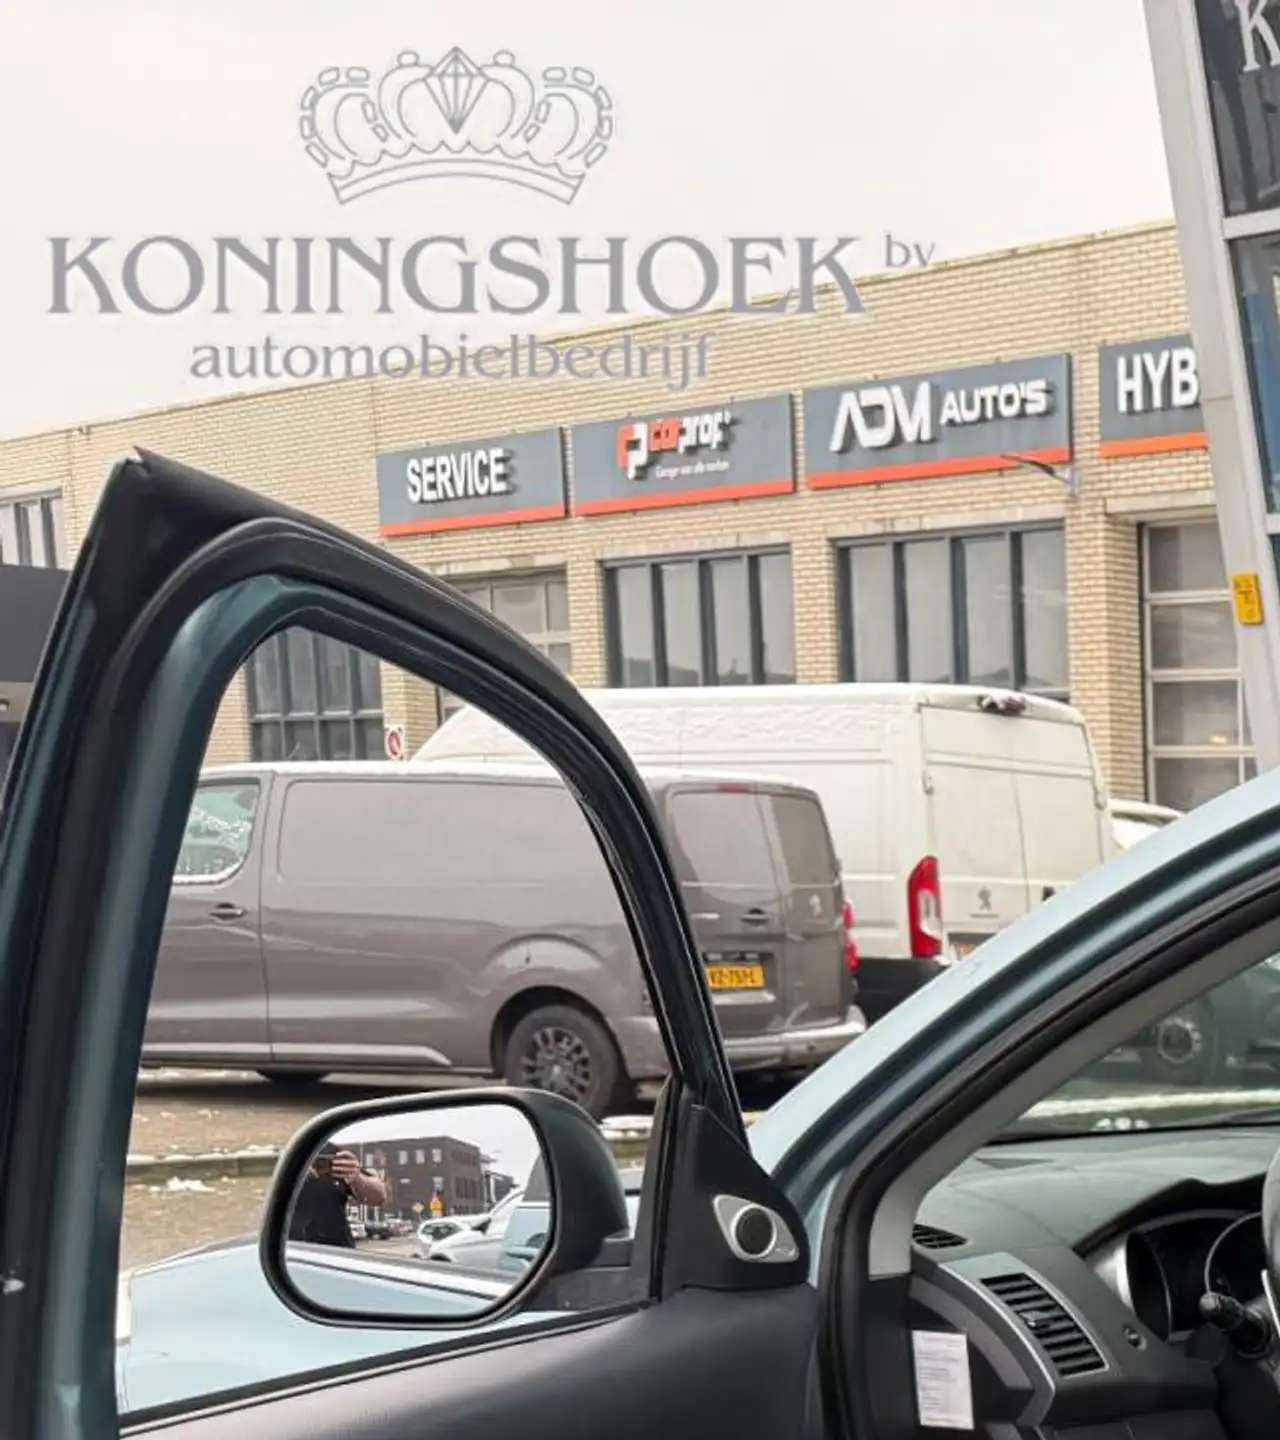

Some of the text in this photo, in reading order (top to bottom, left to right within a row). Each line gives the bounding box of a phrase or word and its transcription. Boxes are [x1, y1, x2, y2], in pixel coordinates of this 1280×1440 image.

[829, 379, 1047, 452] ADM AUTO'S
[407, 447, 507, 502] SERVICE
